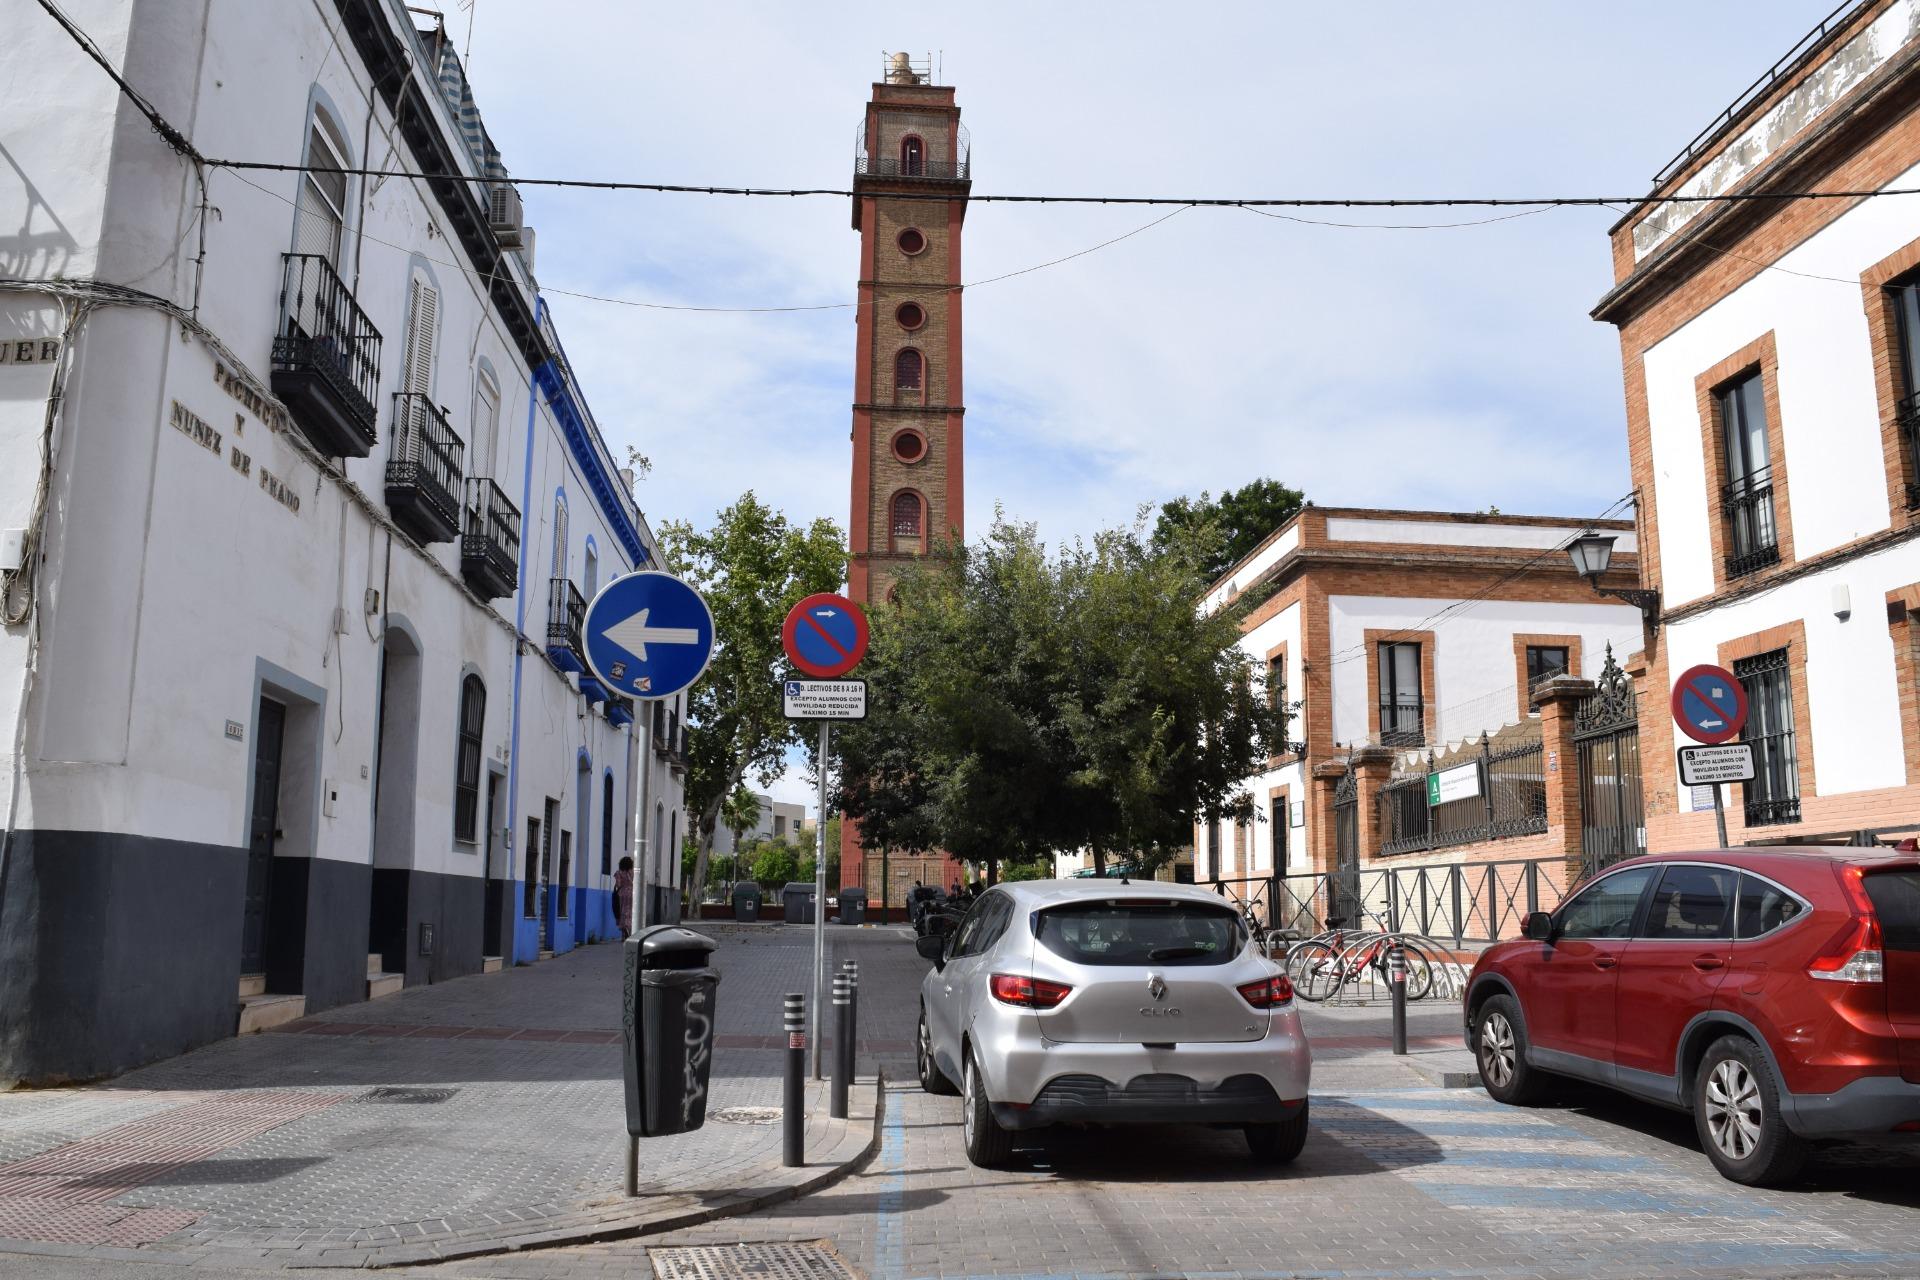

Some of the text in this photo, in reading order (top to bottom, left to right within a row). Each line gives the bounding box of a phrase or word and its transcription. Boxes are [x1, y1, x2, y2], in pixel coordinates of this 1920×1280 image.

[234, 412, 245, 438] Y
[231, 445, 251, 478] DE
[846, 685, 850, 693] A
[858, 685, 863, 693] H
[1140, 1007, 1181, 1017] CLIO
